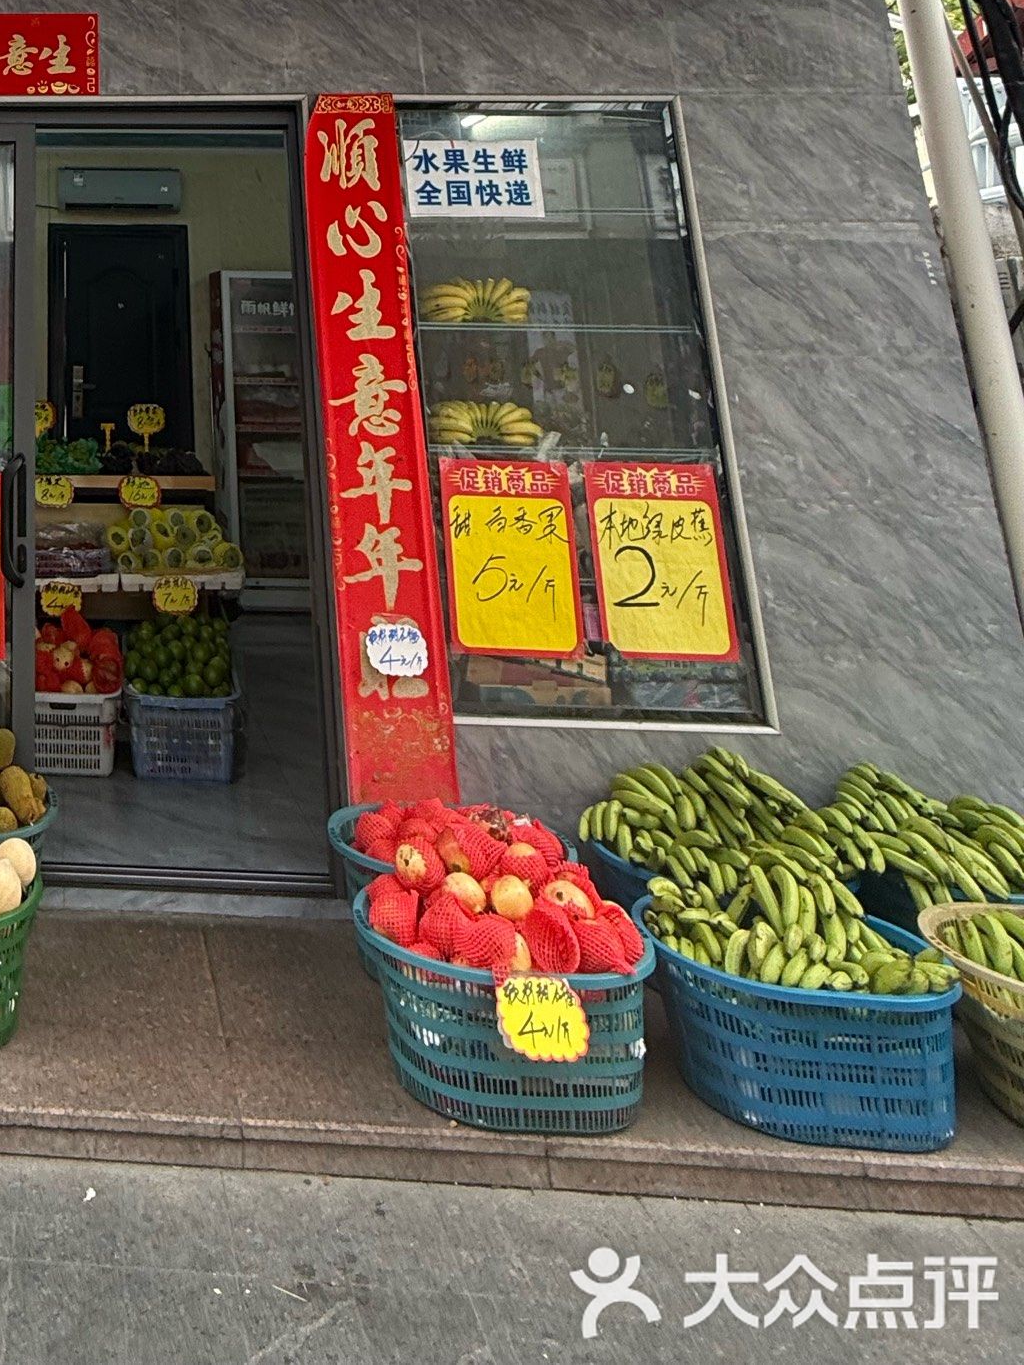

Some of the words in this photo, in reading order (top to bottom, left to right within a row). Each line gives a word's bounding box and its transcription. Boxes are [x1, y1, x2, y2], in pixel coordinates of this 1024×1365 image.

[411, 147, 529, 176] 水果生鲜
[414, 179, 534, 209] 全国快递
[458, 468, 552, 495] 促销商品
[603, 470, 698, 497] 促销商品
